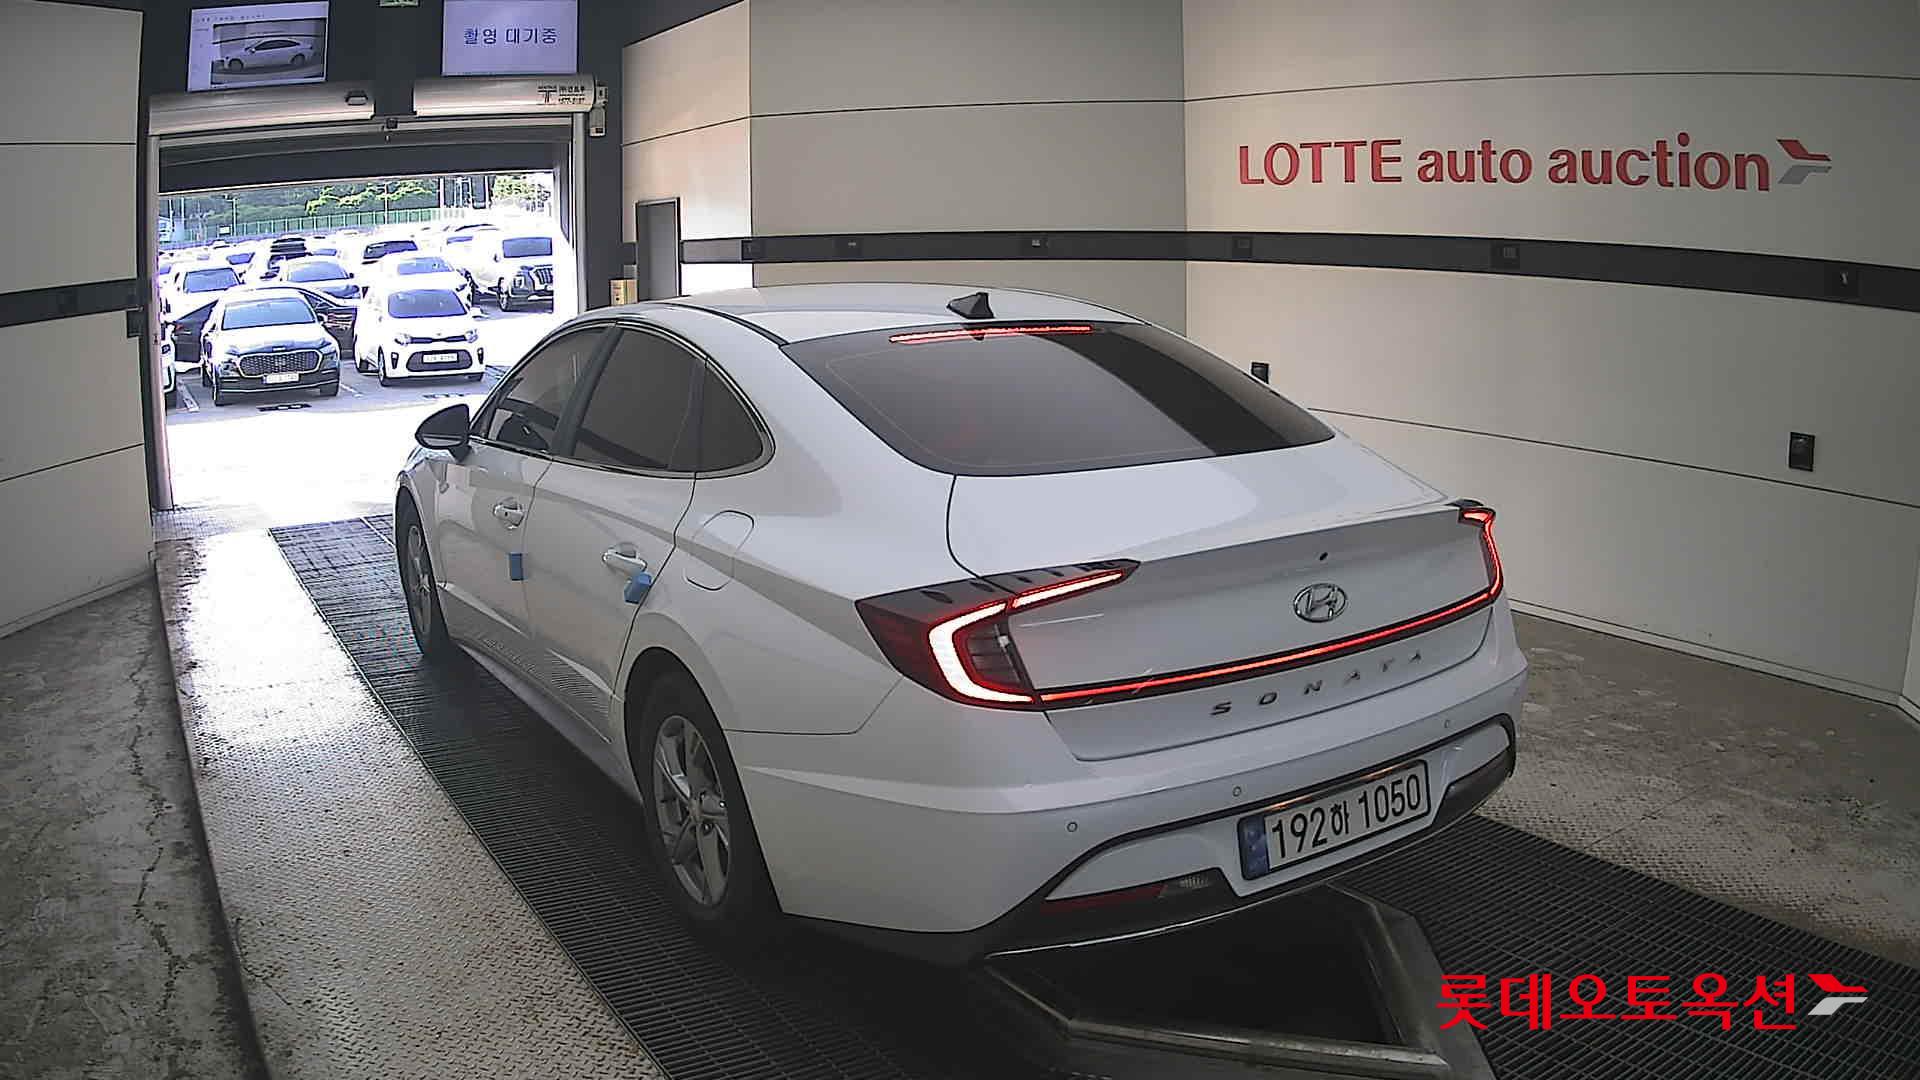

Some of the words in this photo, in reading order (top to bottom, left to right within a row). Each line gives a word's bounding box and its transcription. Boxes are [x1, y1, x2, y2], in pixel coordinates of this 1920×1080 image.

[464, 27, 497, 45] 촬영
[505, 27, 558, 45] 대기중
[1239, 139, 1402, 185] LOTTE
[1417, 140, 1532, 185] auto
[1548, 133, 1770, 191] auction
[1210, 650, 1423, 716] SONATA
[1271, 800, 1350, 859] 192하
[1358, 774, 1422, 828] 1050
